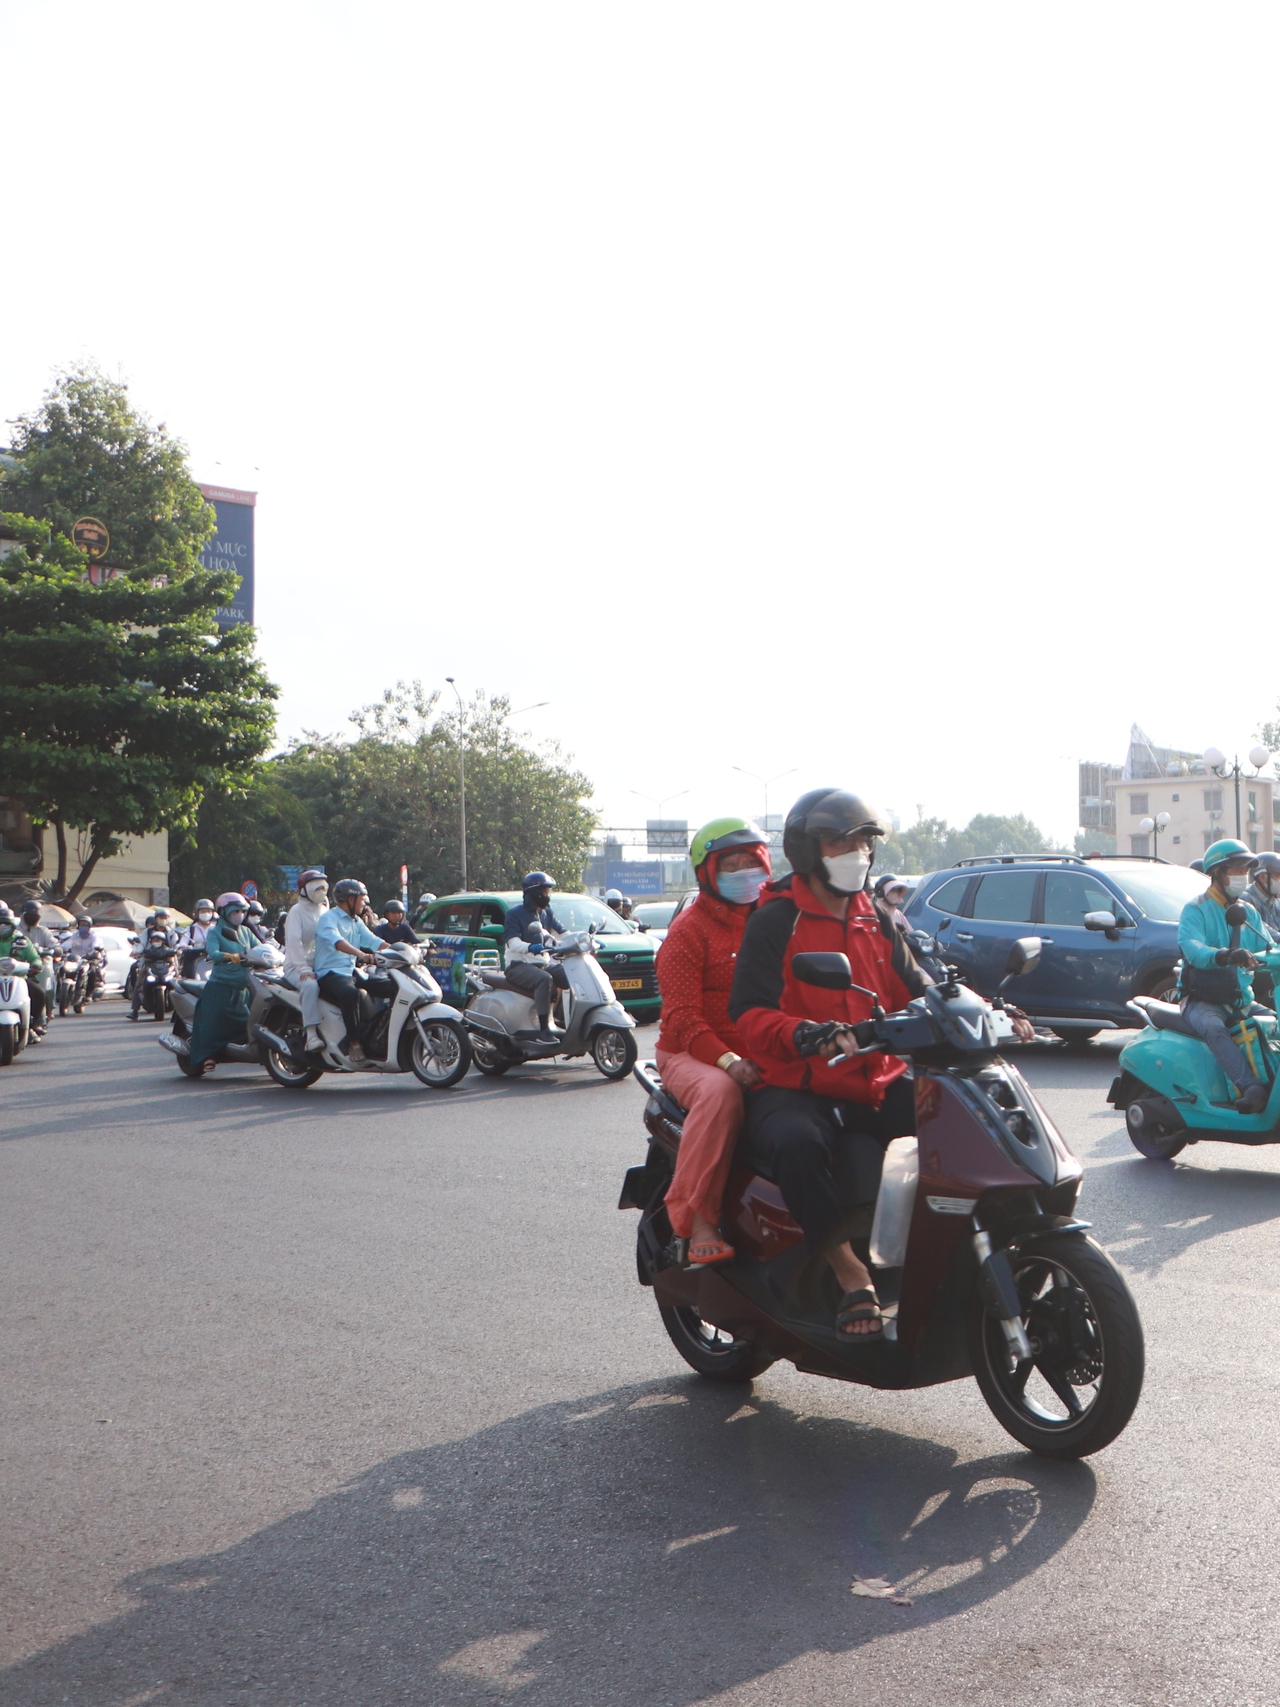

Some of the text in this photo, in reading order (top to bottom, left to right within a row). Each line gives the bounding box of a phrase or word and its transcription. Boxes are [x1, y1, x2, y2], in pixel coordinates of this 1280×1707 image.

[208, 489, 252, 502] GAMUDA LAND
[216, 540, 247, 557] MỰC
[216, 607, 245, 619] PARK
